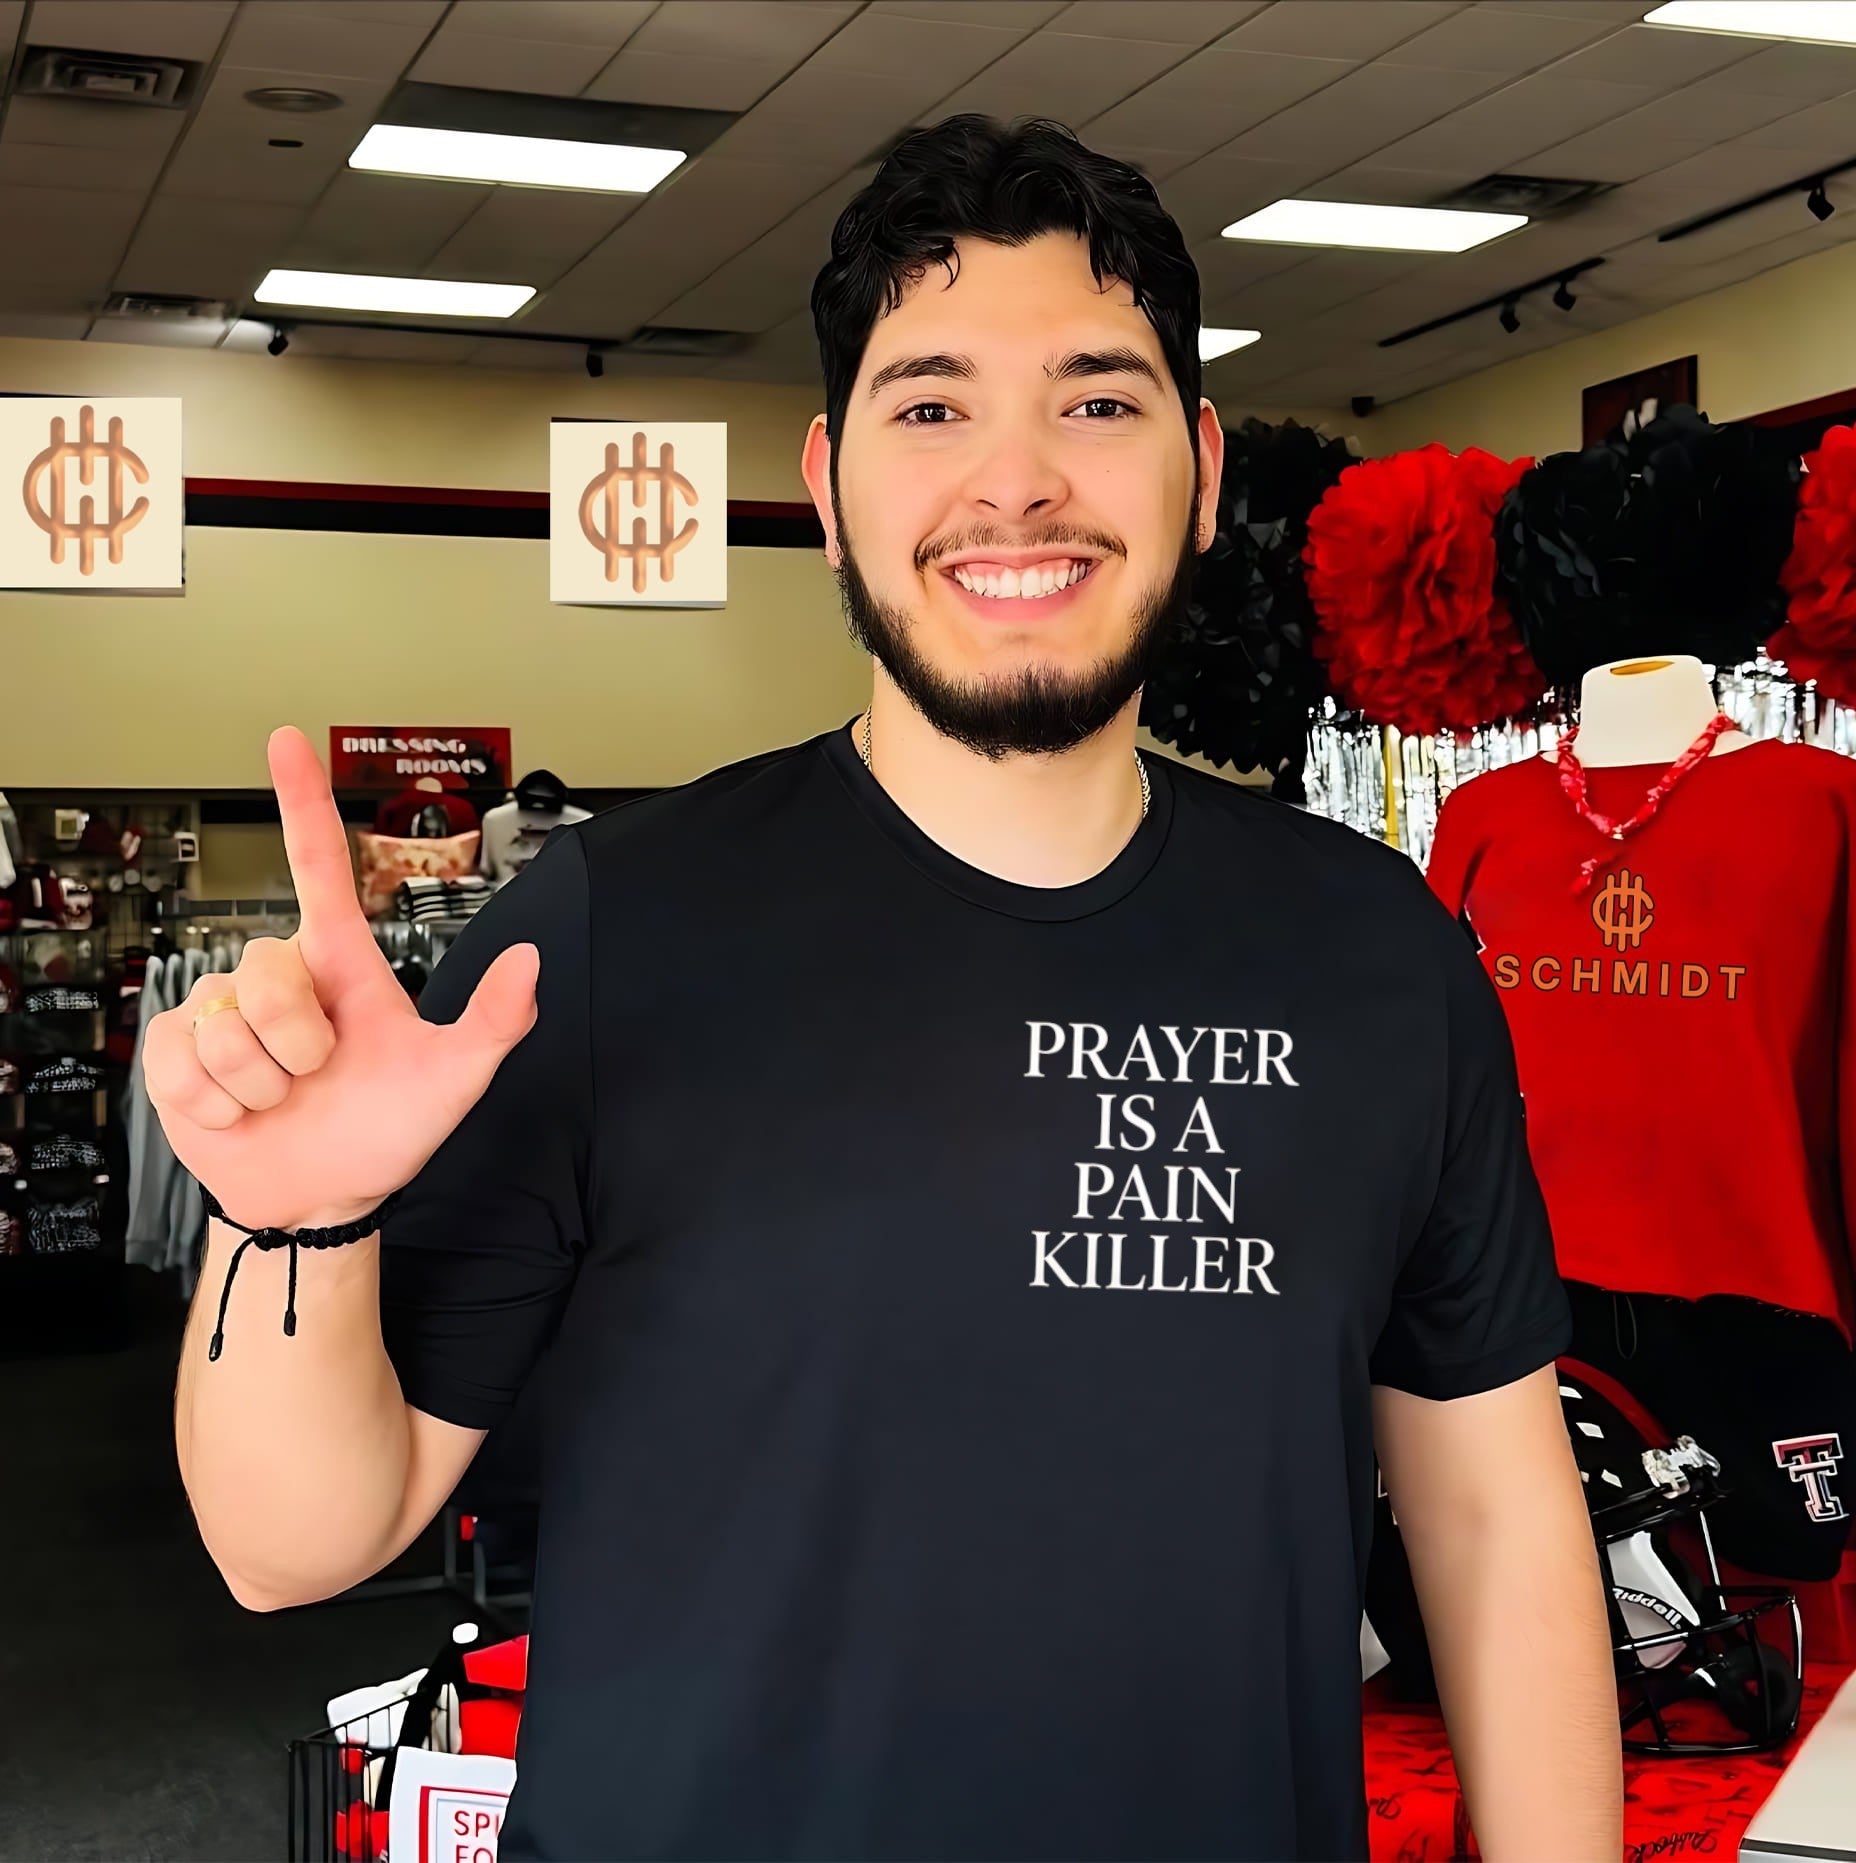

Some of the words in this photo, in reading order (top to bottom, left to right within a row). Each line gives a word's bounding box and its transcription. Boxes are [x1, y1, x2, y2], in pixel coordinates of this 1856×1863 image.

[396, 758, 487, 775] ROOMS
[1494, 954, 1747, 1000] SCHMIDT
[1023, 1020, 1300, 1087] PRAYER
[1094, 1093, 1156, 1151] IS
[1172, 1096, 1226, 1154] A
[1072, 1162, 1242, 1225] PAIN
[1029, 1230, 1281, 1296] KILLER
